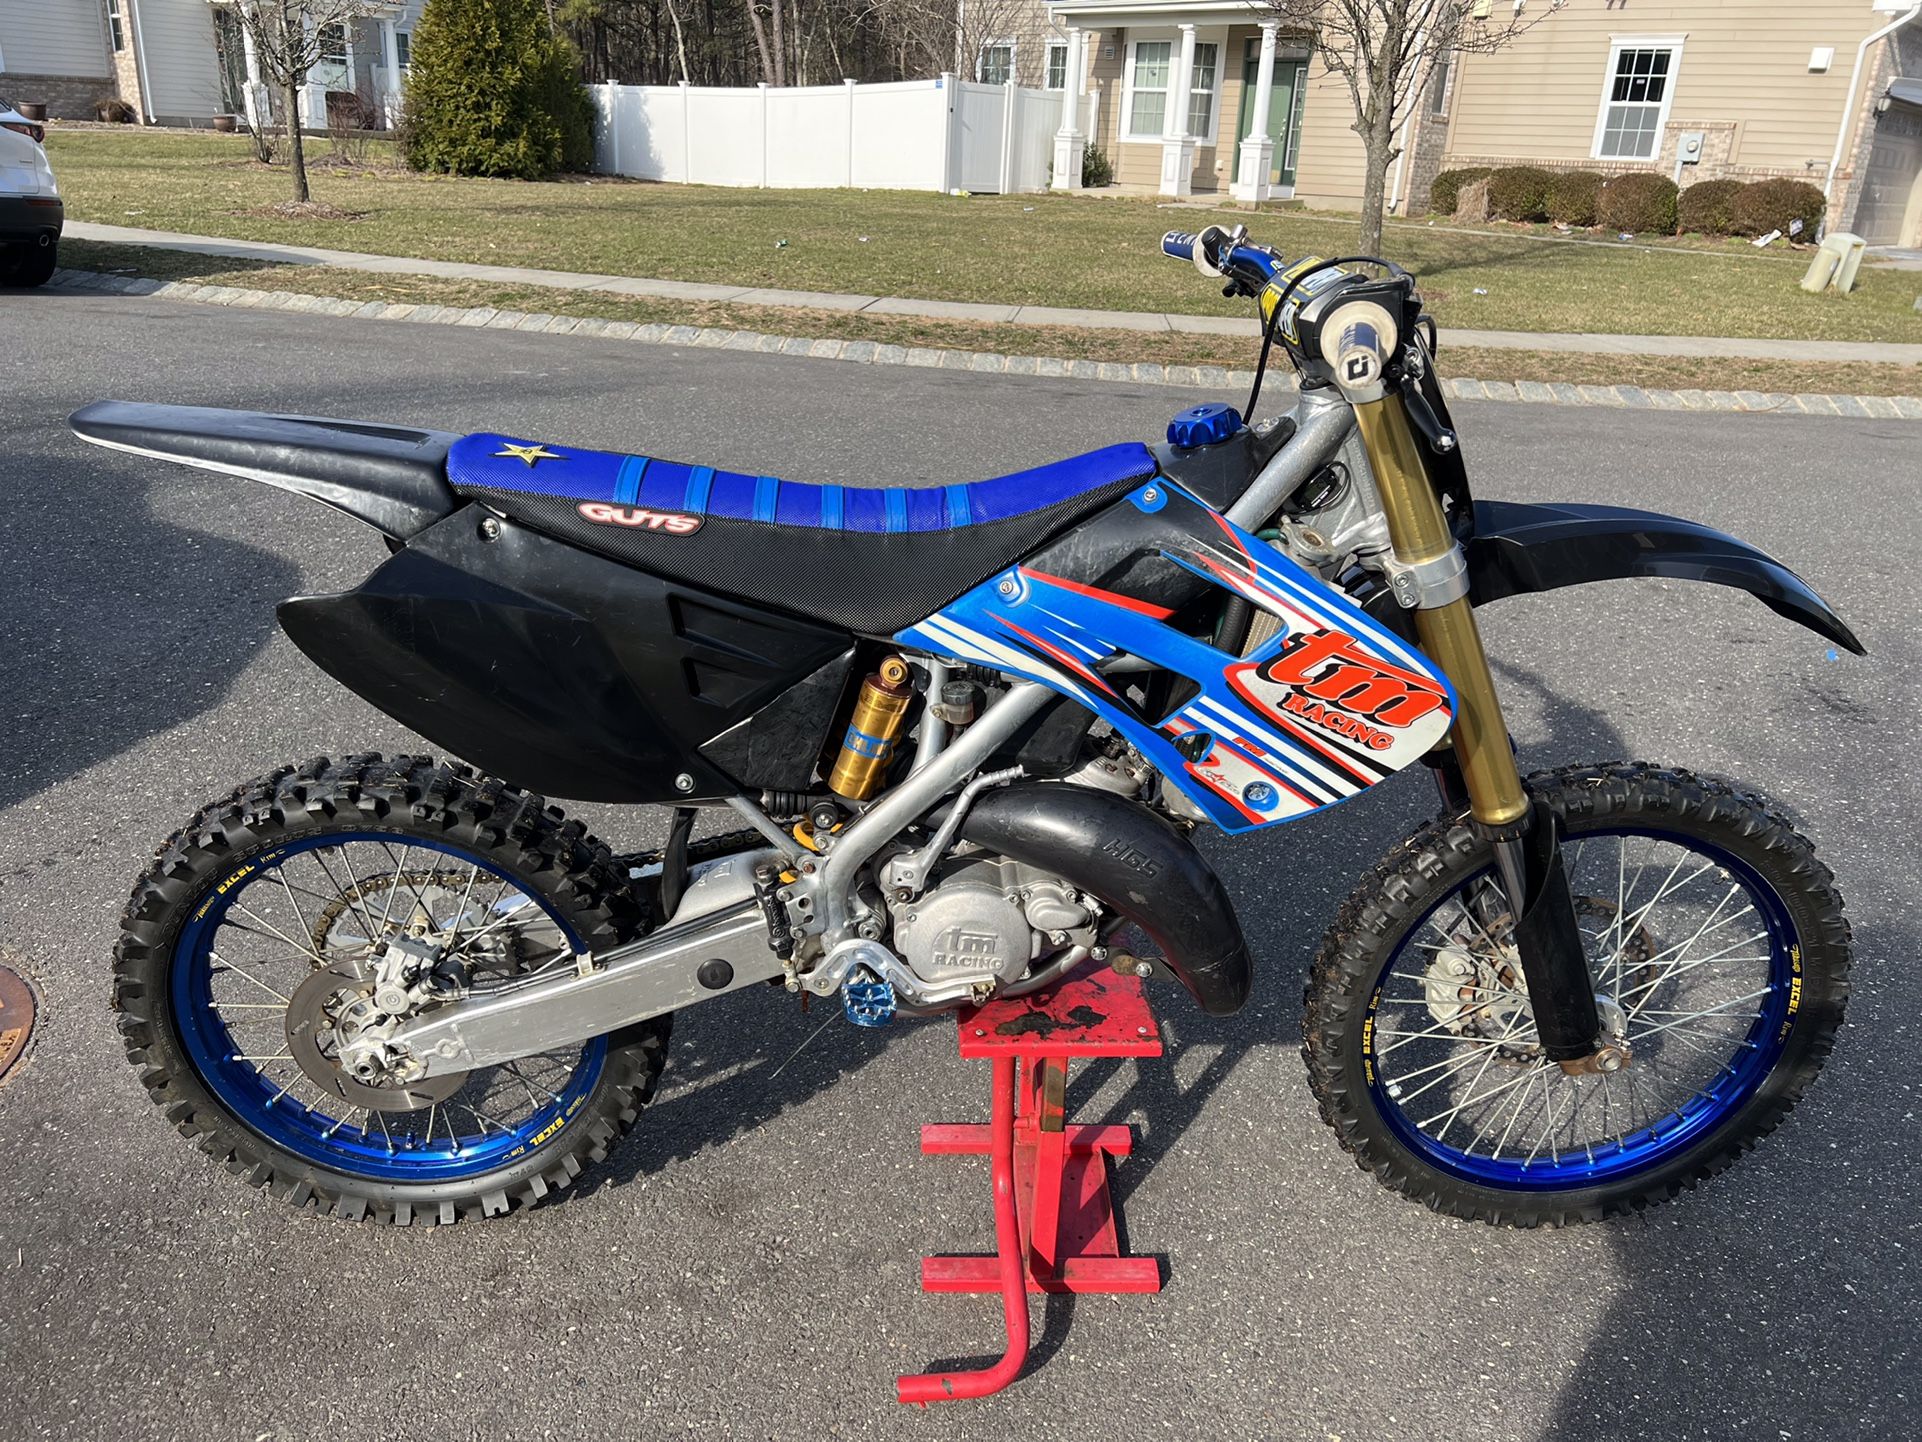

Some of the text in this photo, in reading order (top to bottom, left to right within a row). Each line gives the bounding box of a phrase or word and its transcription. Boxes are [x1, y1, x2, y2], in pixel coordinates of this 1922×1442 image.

[578, 503, 700, 533] GUTS
[1277, 692, 1395, 750] RACING
[1102, 838, 1163, 880] HGS
[216, 865, 256, 895] EXCEL
[932, 951, 1005, 971] RACING
[1787, 977, 1802, 1015] EXCEL
[1363, 1016, 1373, 1054] EXCEL
[529, 1117, 565, 1146] EXCEL
